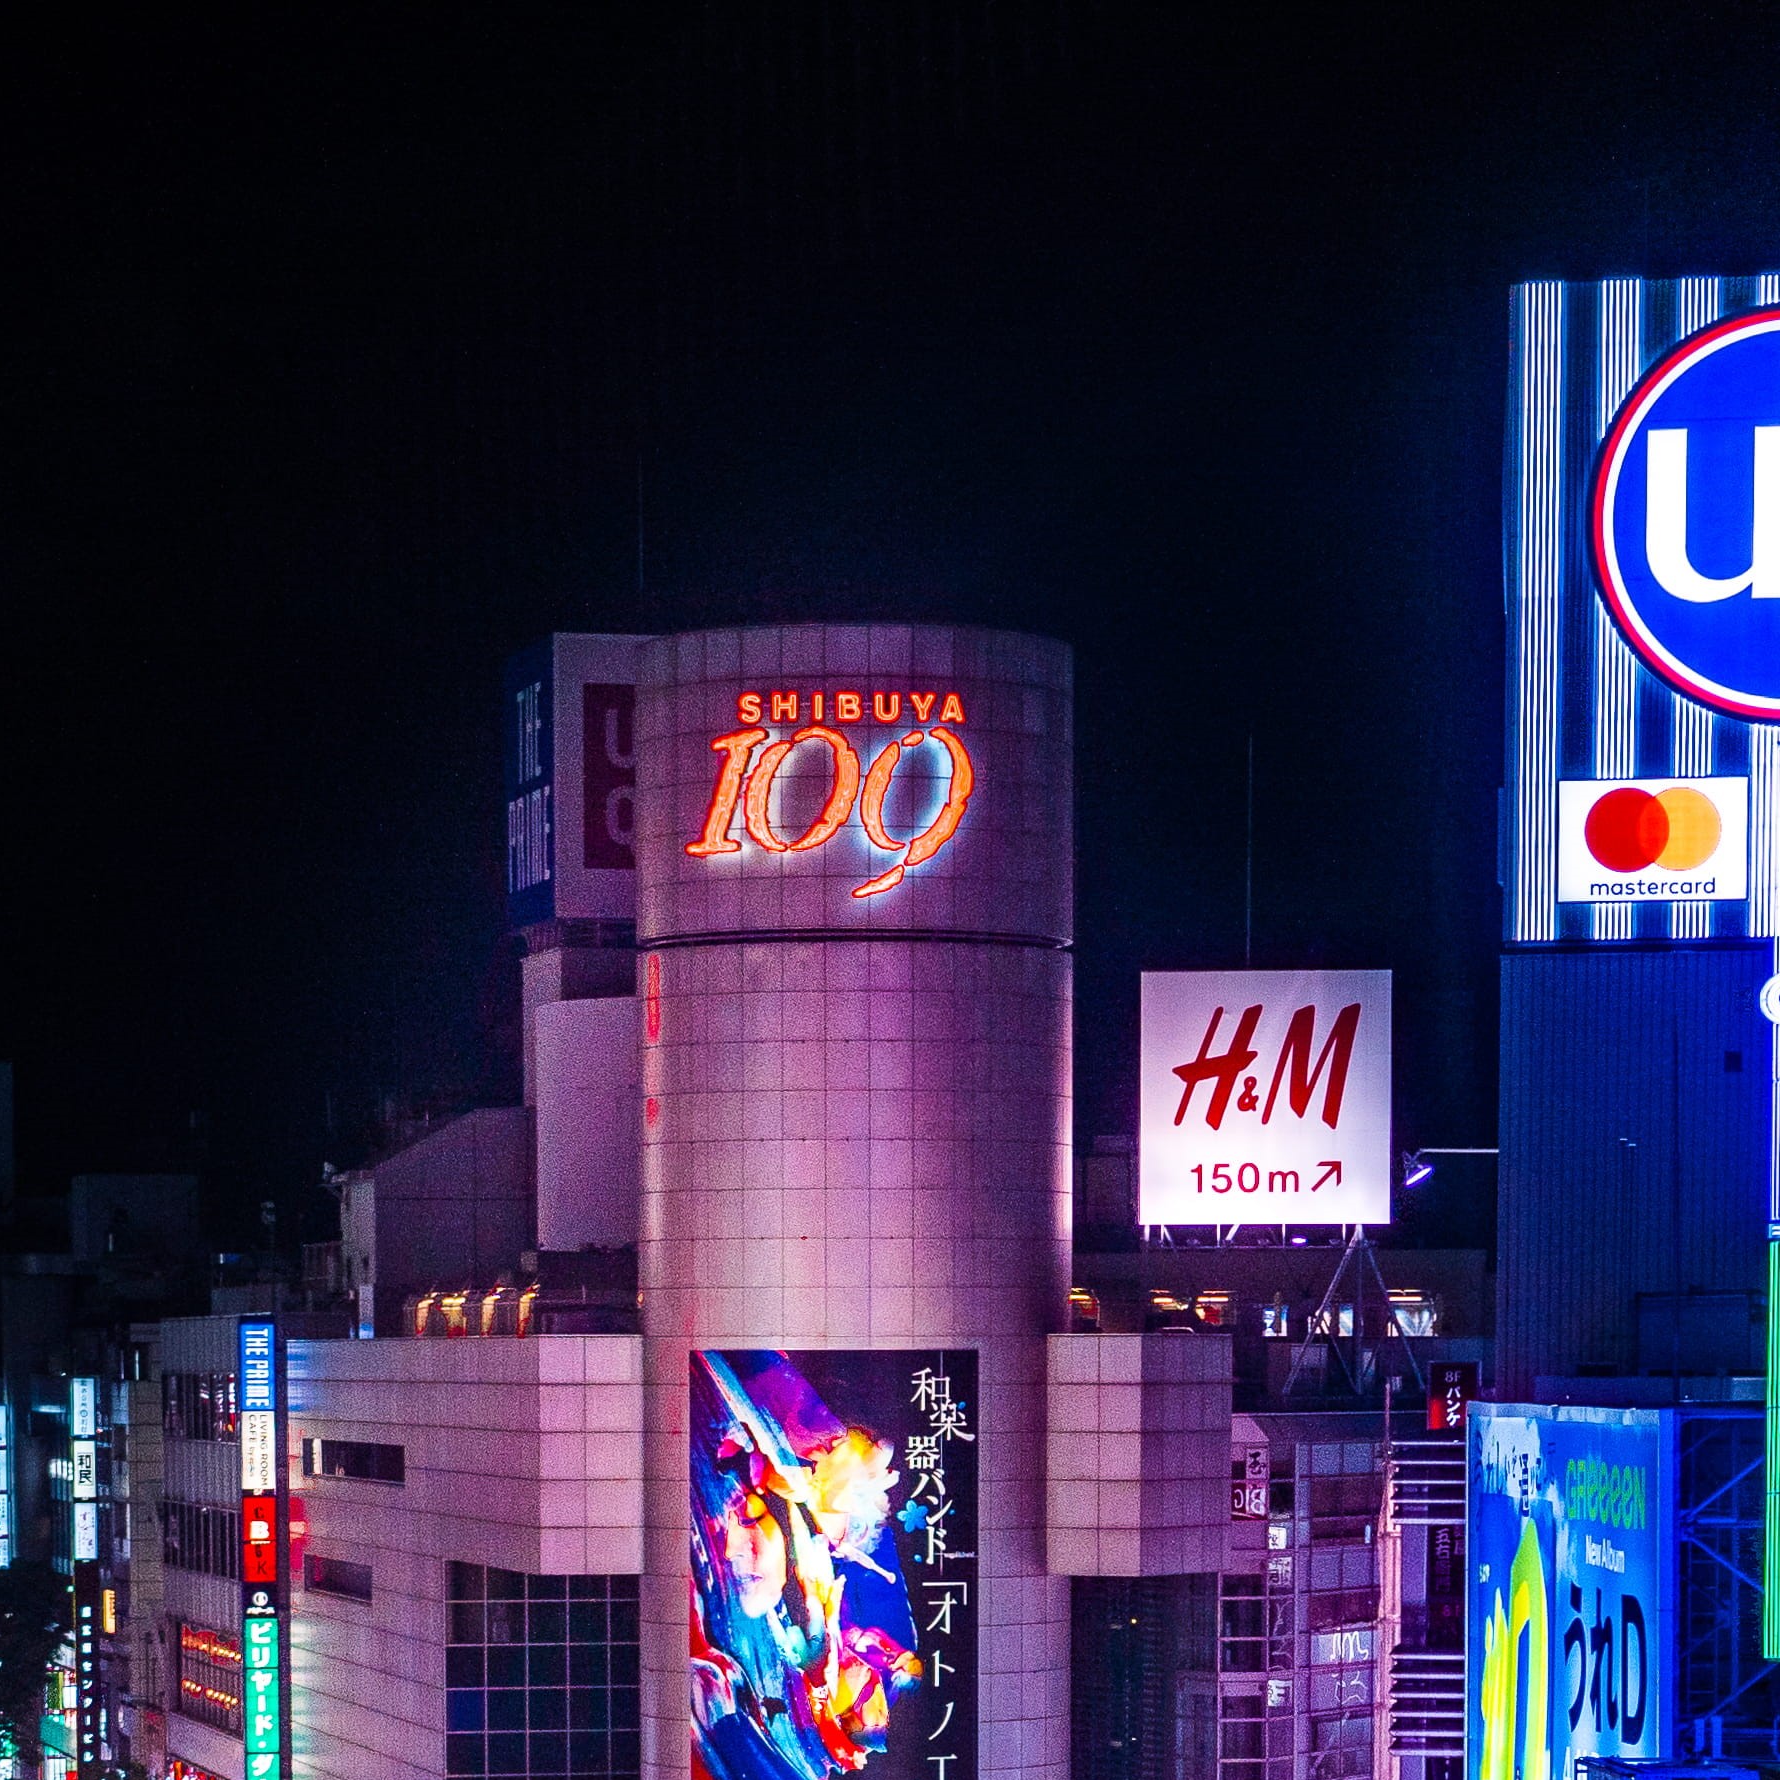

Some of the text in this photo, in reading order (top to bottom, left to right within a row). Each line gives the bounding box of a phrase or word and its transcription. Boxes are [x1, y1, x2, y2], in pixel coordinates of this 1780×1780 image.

[737, 691, 966, 724] SHIBUYA
[684, 725, 975, 899] 109
[1590, 876, 1717, 897] mastercard
[1172, 1003, 1362, 1131] H&M
[245, 1327, 270, 1407] THE PRIME
[1444, 1371, 1462, 1383] 8F
[904, 1368, 975, 1566] 和楽器バンド
[1601, 1537, 1626, 1574] Album
